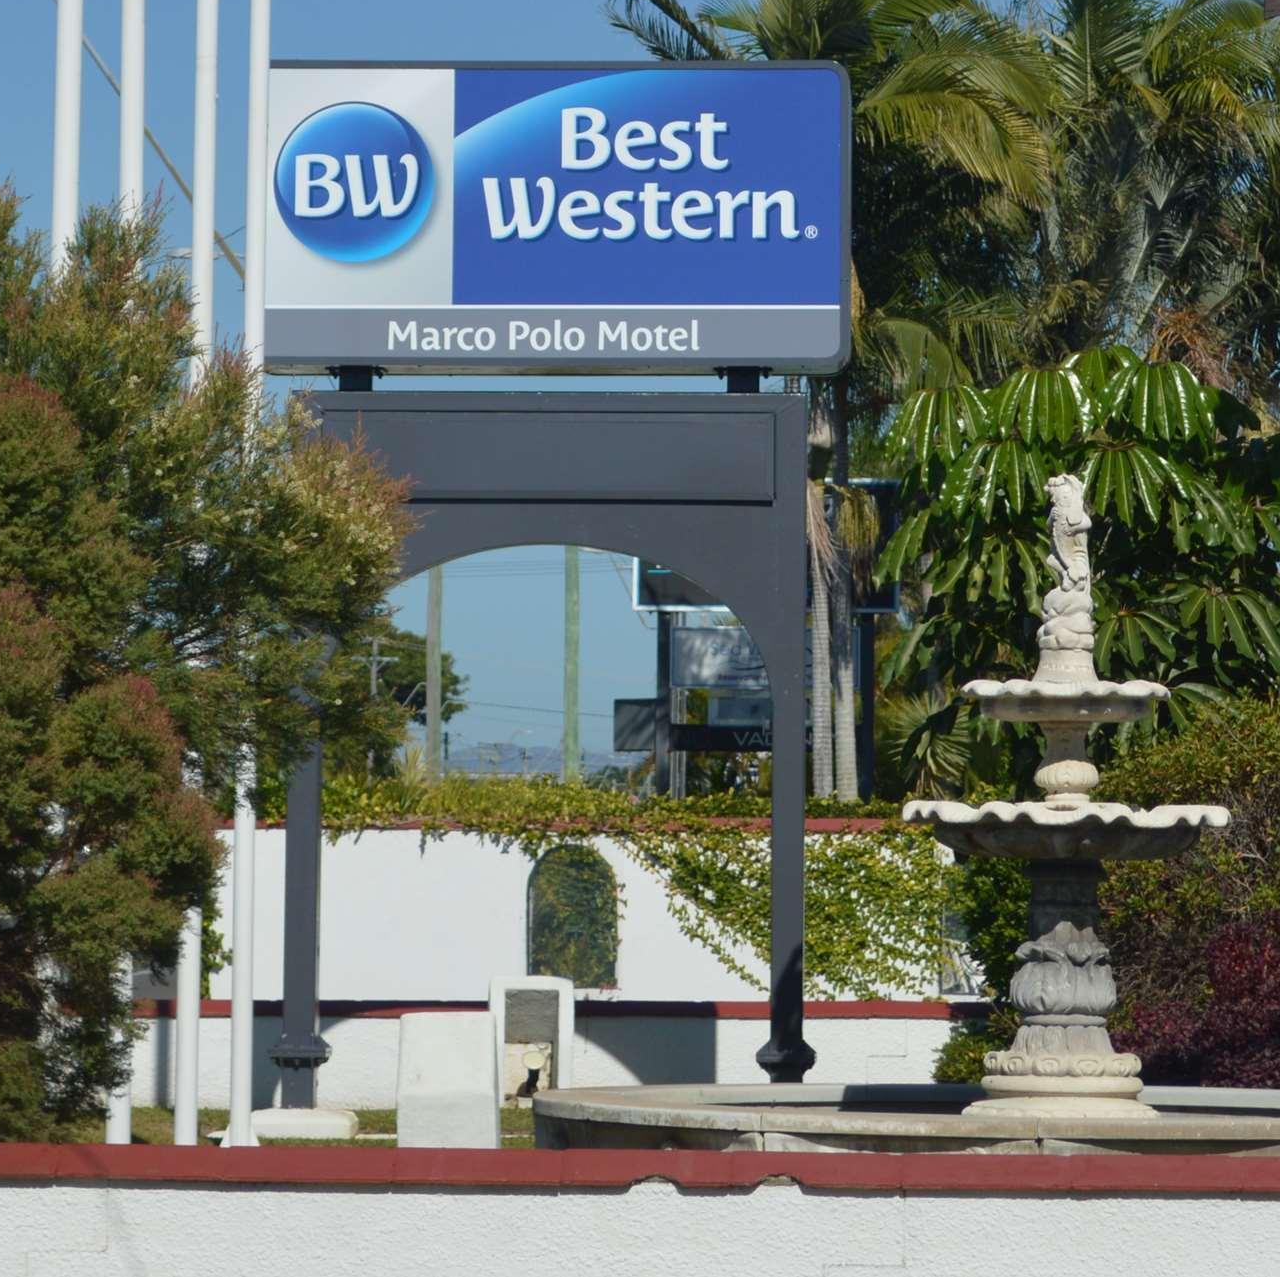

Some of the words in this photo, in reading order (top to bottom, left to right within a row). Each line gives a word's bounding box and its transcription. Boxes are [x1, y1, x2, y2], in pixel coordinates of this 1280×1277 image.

[561, 106, 729, 171] Best
[293, 153, 419, 218] BW
[387, 320, 496, 351] Marco
[508, 319, 585, 351] Polo
[597, 319, 700, 351] Motel
